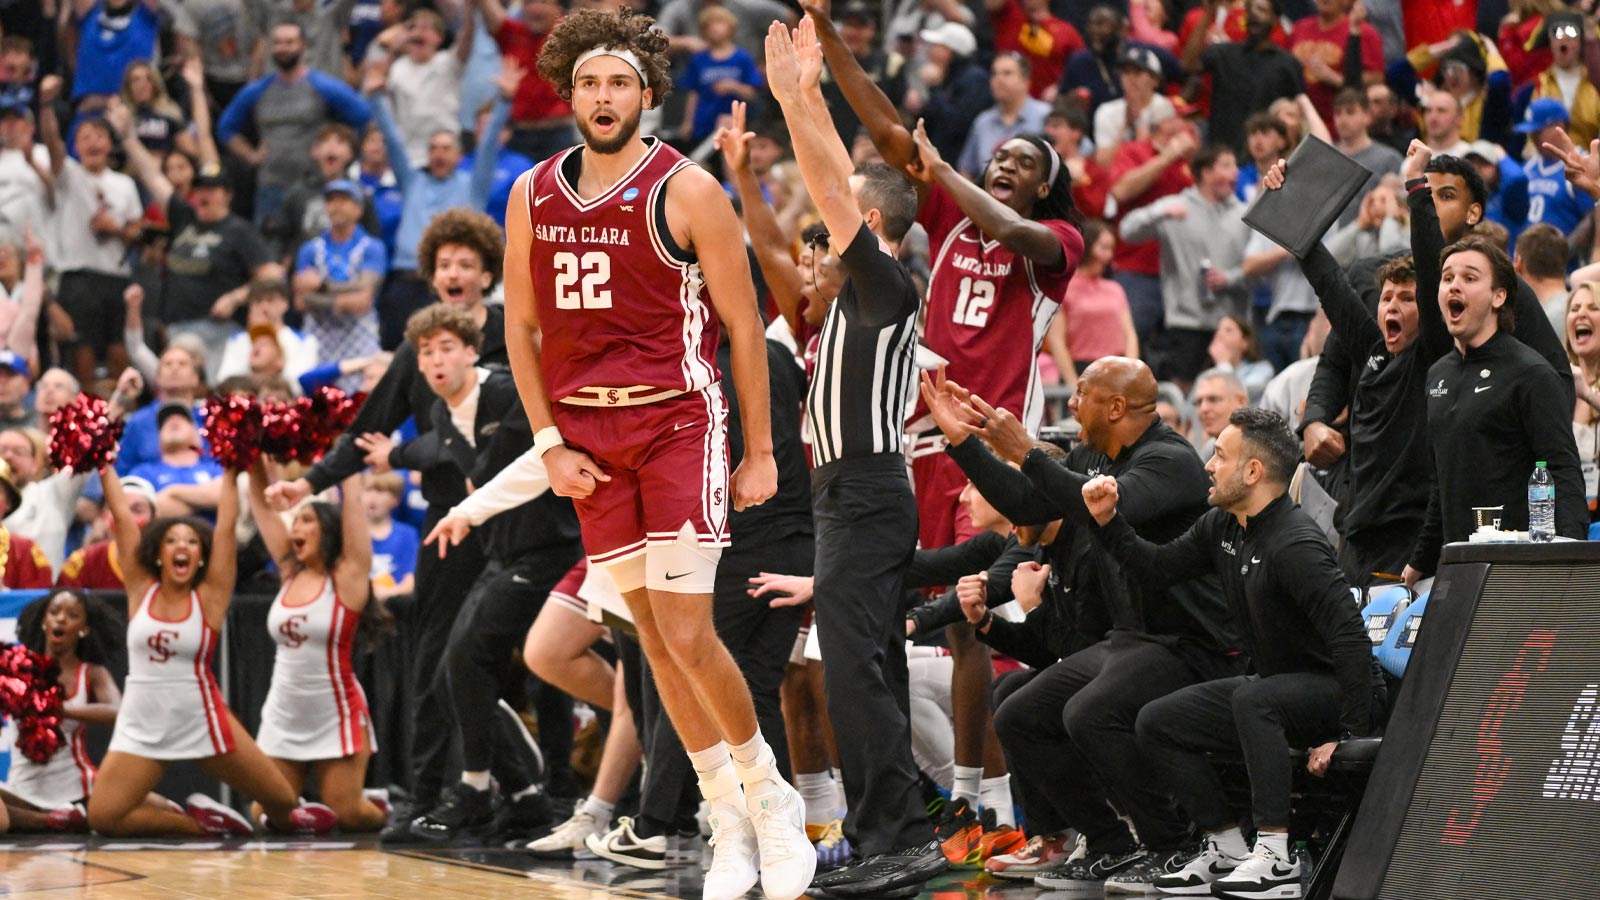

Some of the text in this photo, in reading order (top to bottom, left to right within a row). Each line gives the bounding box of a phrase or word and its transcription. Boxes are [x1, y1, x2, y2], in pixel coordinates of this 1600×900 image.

[535, 223, 630, 246] SANTA CLARA
[553, 251, 613, 310] 22
[952, 276, 996, 328] 12
